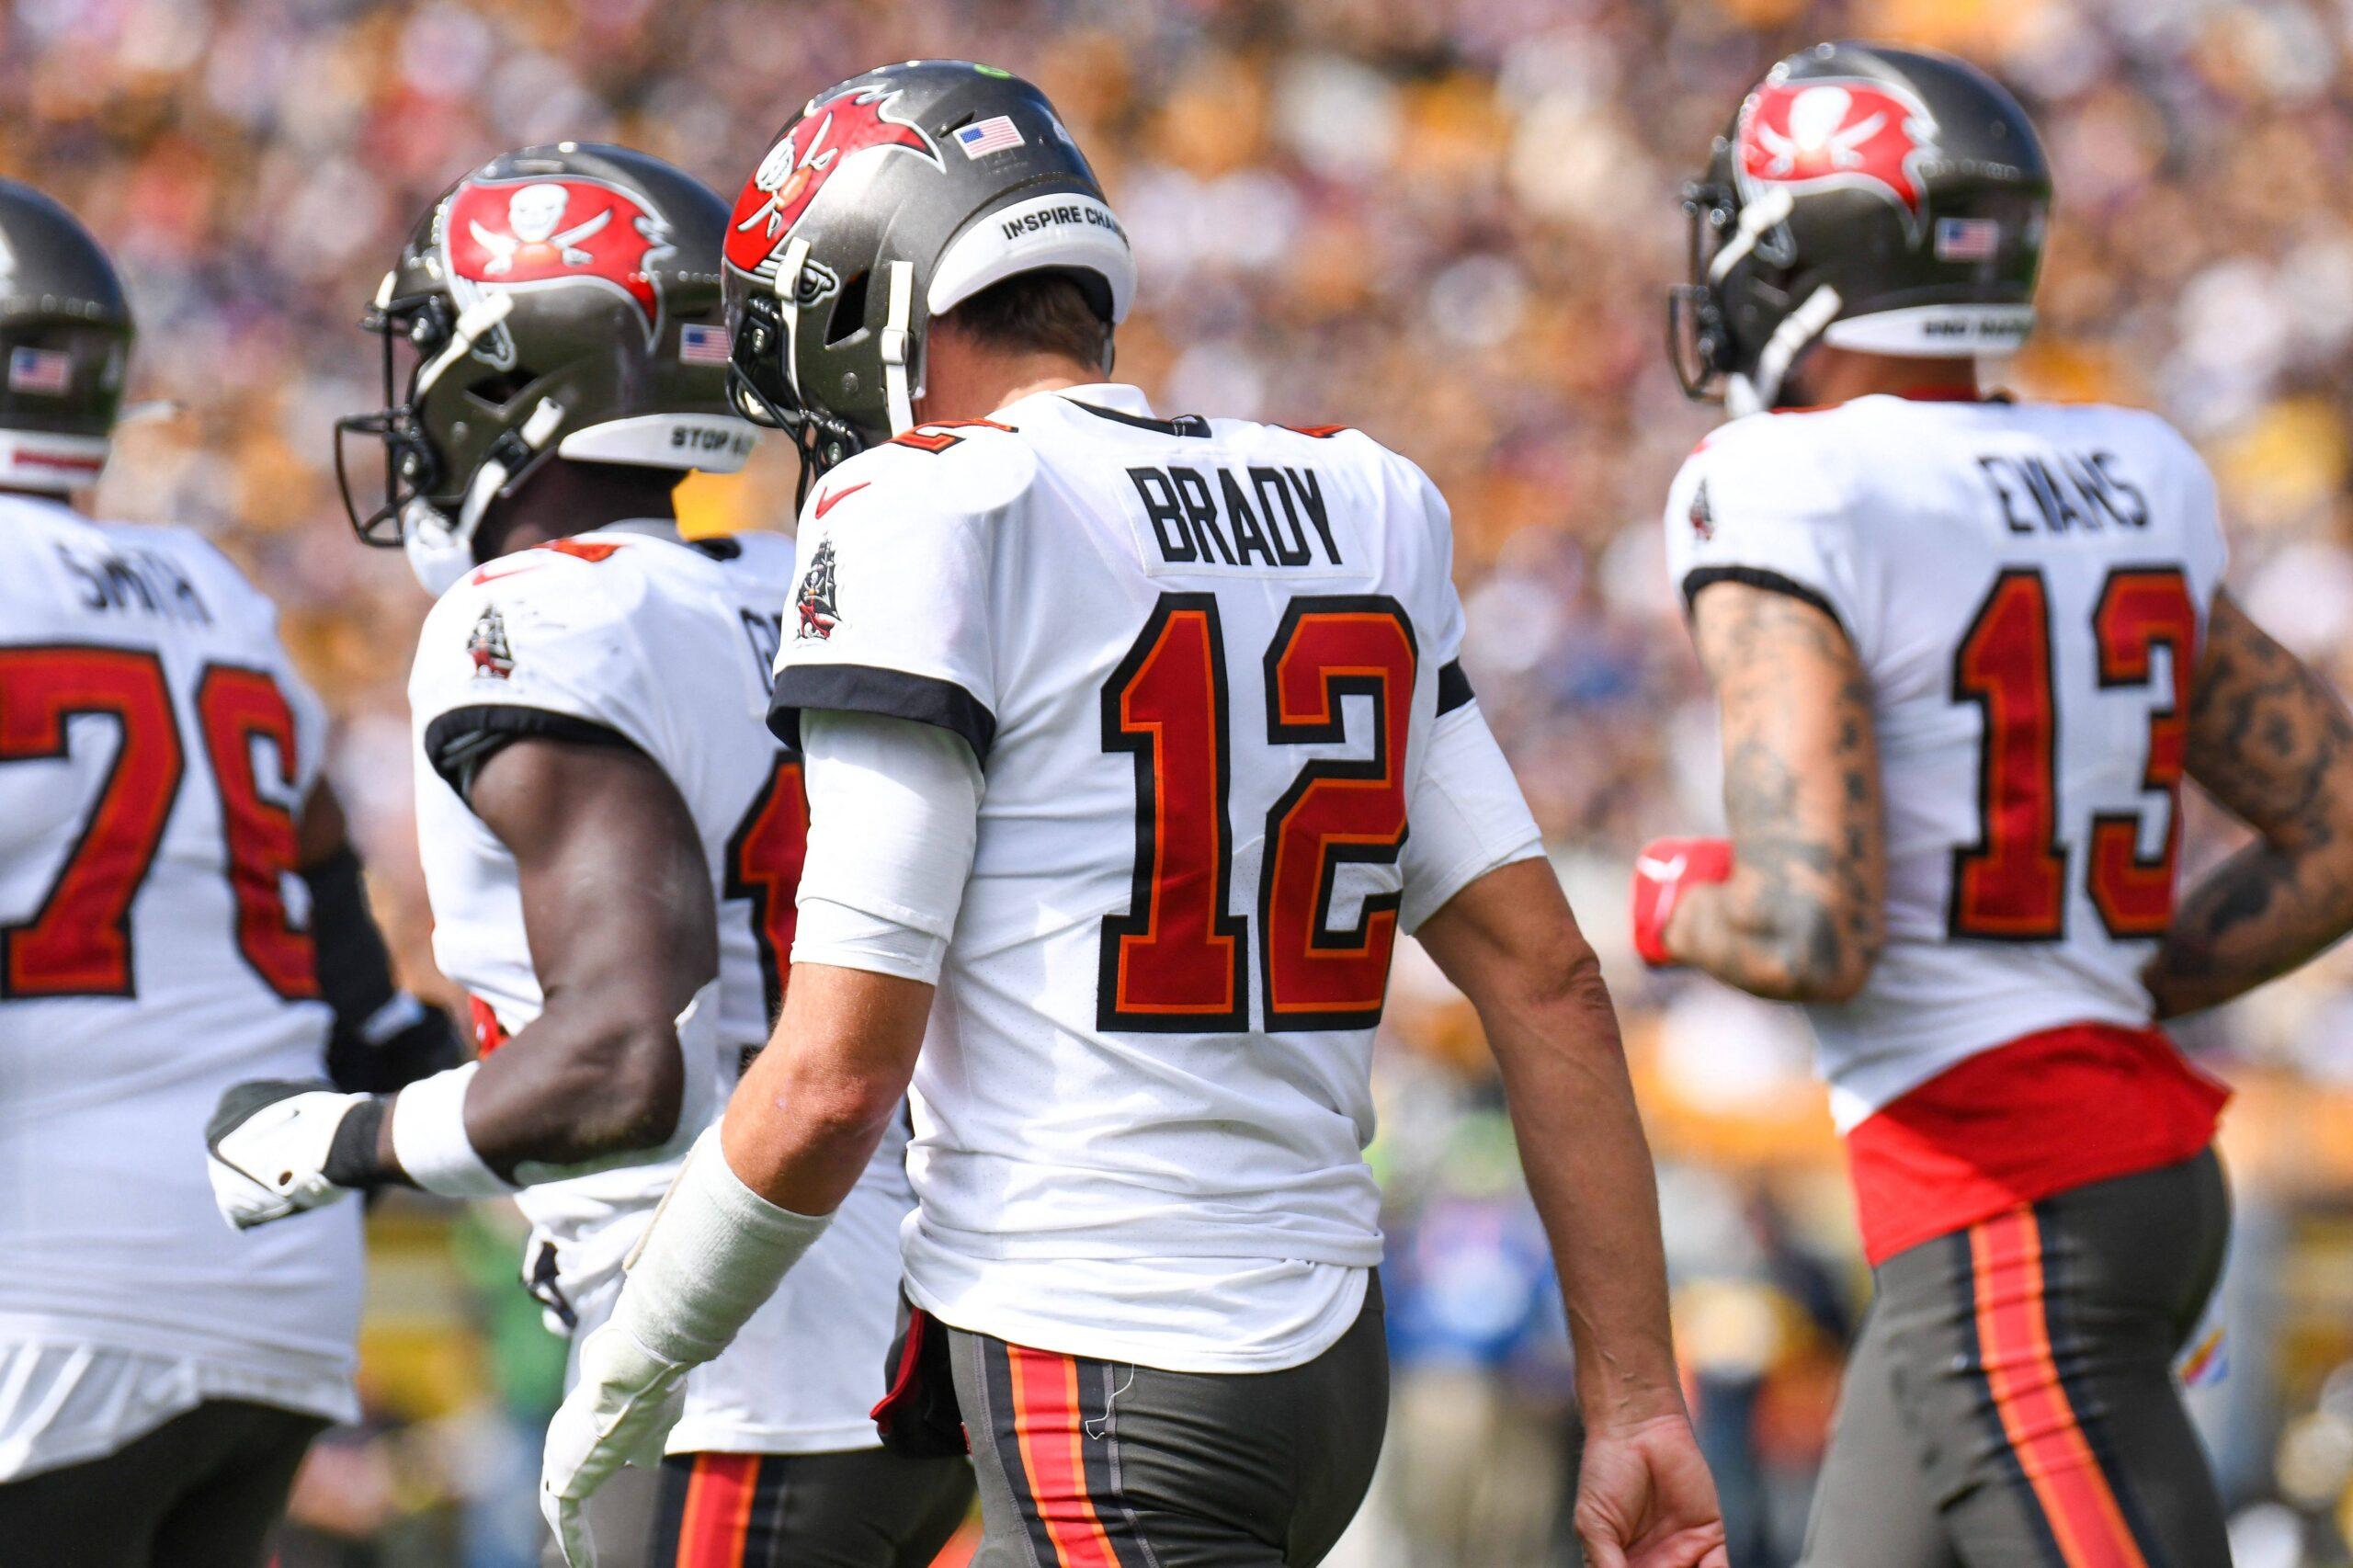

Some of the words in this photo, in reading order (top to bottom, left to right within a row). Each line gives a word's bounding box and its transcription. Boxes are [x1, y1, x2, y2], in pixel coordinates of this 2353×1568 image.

[1002, 205, 1083, 240] INSPIRE
[1086, 207, 1130, 250] CHA
[671, 426, 730, 450] STOP
[1127, 466, 1343, 565] BRADY
[1976, 452, 2150, 532] EVANS
[1947, 564, 2196, 941] 13
[0, 641, 322, 1001] 76
[1097, 592, 1418, 1033] 12
